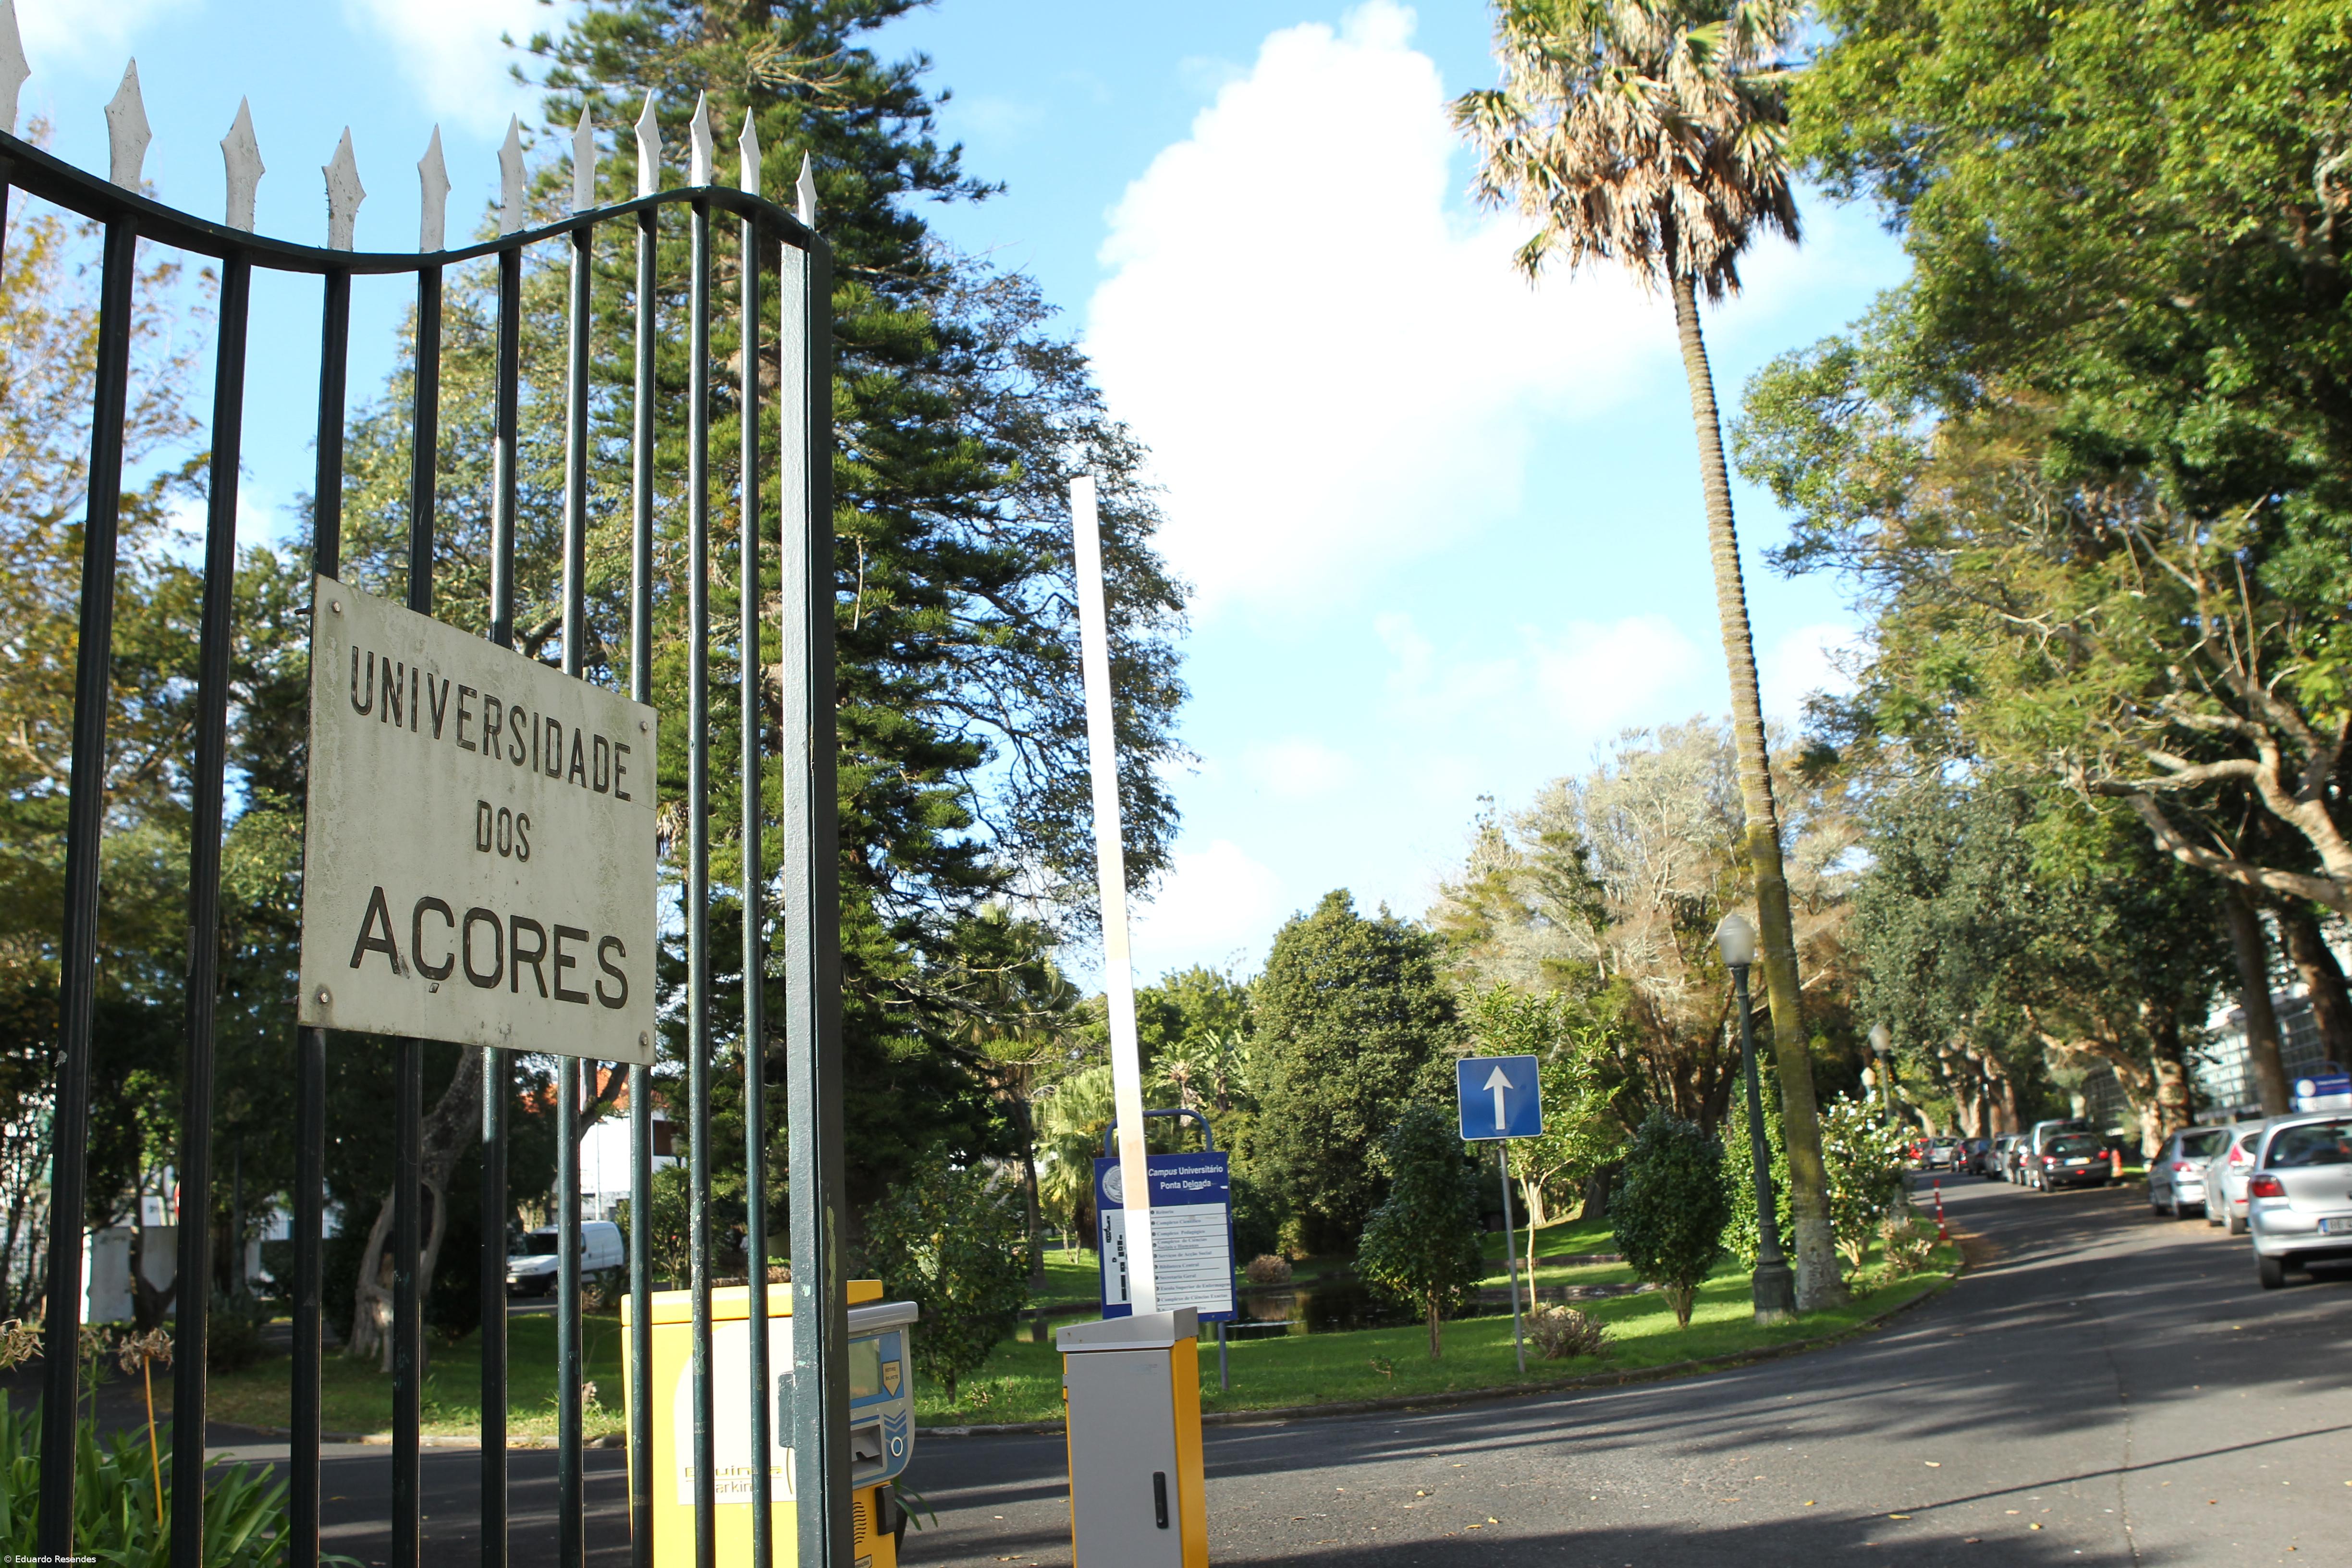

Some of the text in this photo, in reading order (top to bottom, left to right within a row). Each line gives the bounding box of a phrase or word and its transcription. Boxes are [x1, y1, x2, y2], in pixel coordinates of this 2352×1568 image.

[351, 645, 631, 801] UNIVERSIDADE
[476, 799, 531, 862] DOS
[349, 885, 629, 1009] AÇORES
[1148, 1164, 1223, 1177] Campus Universitário
[1160, 1179, 1211, 1190] Ponta Delgada
[685, 1465, 781, 1478] Euina
